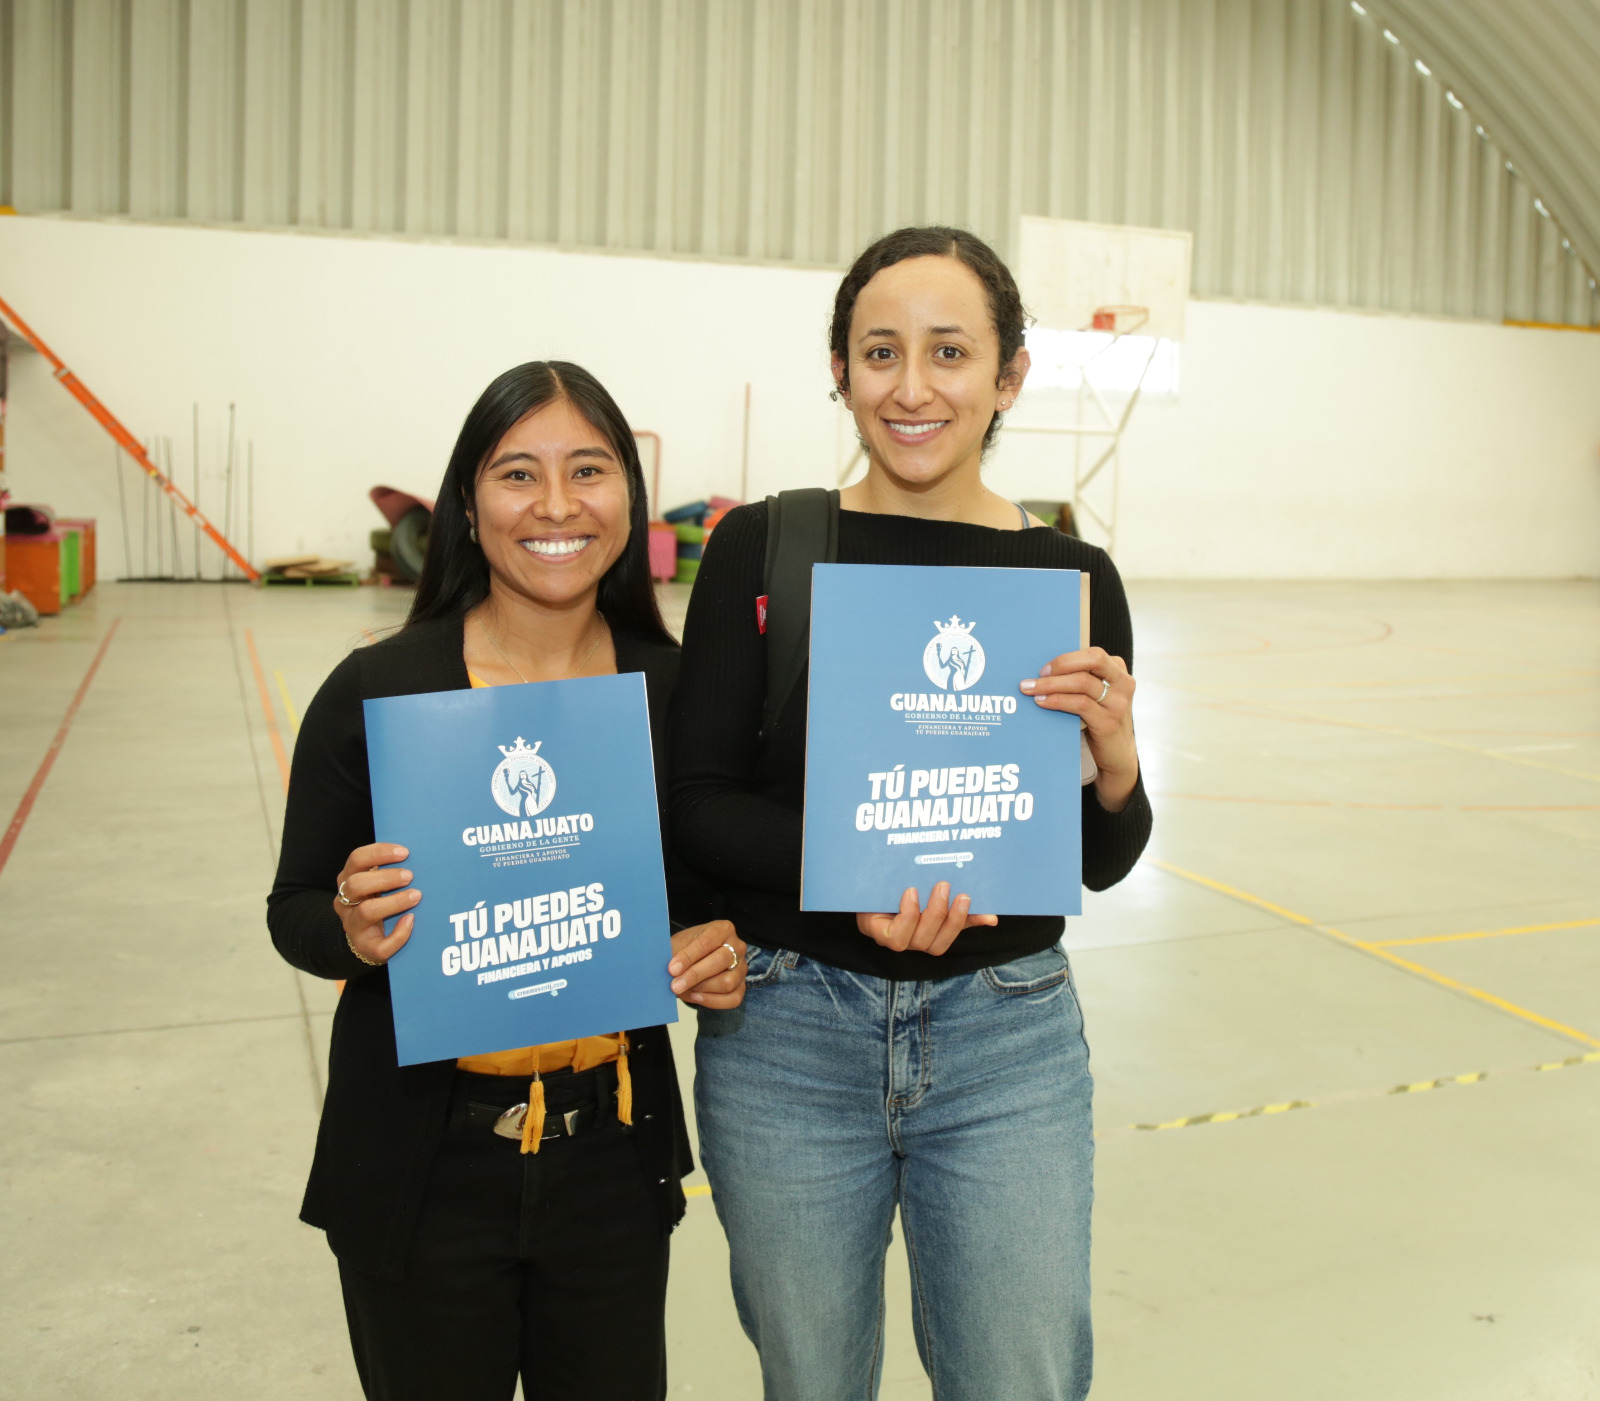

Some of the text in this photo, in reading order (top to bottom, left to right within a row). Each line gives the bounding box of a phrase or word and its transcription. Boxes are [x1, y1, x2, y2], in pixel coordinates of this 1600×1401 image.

[890, 693, 1017, 714] GUANAJUATO
[868, 764, 1020, 800] TÚ PUEDES
[855, 792, 1034, 831] GUANAJUATO
[462, 813, 593, 846] GUANAJUATO
[479, 835, 580, 853] GOBIERNO DE LA GENTE
[887, 826, 1002, 845] FINANCIERA Y APOYOS
[495, 852, 535, 862] FINANCIERA
[542, 848, 567, 857] APOYOS
[529, 854, 570, 863] GUANAJUATO
[449, 882, 604, 942] TÚ PUEDES
[441, 909, 621, 976] GUANAJUATO
[477, 948, 593, 985] FINANCIERA Y APOYOS
